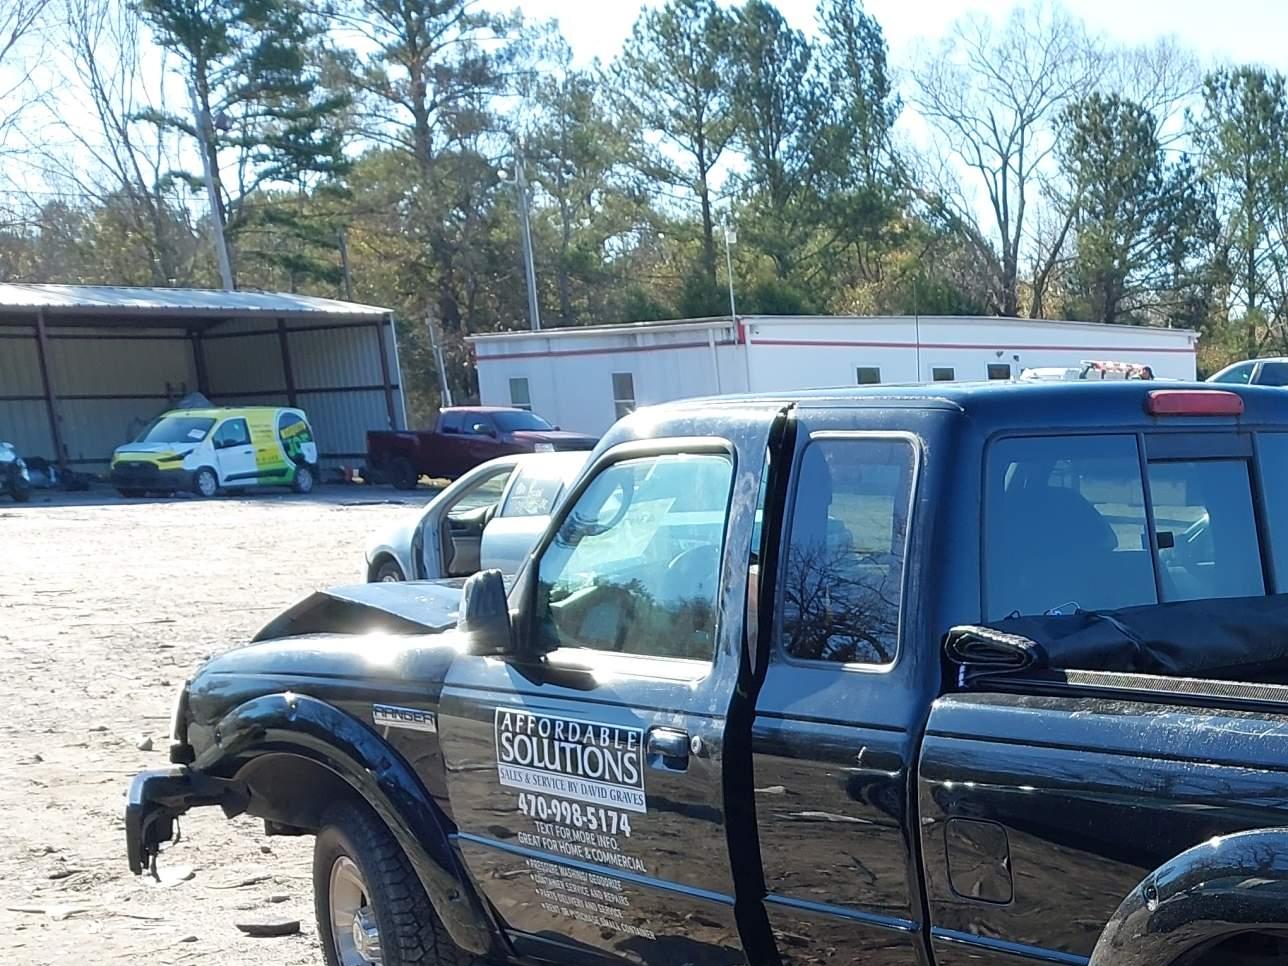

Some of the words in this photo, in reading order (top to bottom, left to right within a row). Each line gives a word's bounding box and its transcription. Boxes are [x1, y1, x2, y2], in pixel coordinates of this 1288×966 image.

[374, 706, 434, 725] RANGER
[501, 712, 637, 751] AFFORDABLE
[501, 732, 638, 784] SOLUTIONS
[501, 768, 523, 782] SALES
[524, 772, 531, 783] &
[533, 774, 566, 791] SERVICE
[568, 781, 579, 793] BY
[581, 784, 607, 798] DAVID
[609, 789, 644, 806] GRAVES
[518, 793, 631, 837] 470-998-5174
[518, 832, 542, 846] GREAT
[543, 836, 558, 851] FOR
[560, 841, 582, 857] HOME
[584, 848, 592, 859] &
[592, 848, 647, 872] COMMERCIAL
[534, 821, 554, 835] TEXT
[556, 823, 572, 839] FOR
[573, 829, 595, 844] MORE
[597, 834, 620, 850] INFO.
[565, 882, 590, 897] SERVICE
[590, 889, 604, 900] AND
[603, 891, 629, 906] REPAIRS
[584, 900, 598, 911] AND
[597, 904, 624, 919] SERVICE
[599, 917, 621, 931] SMALL
